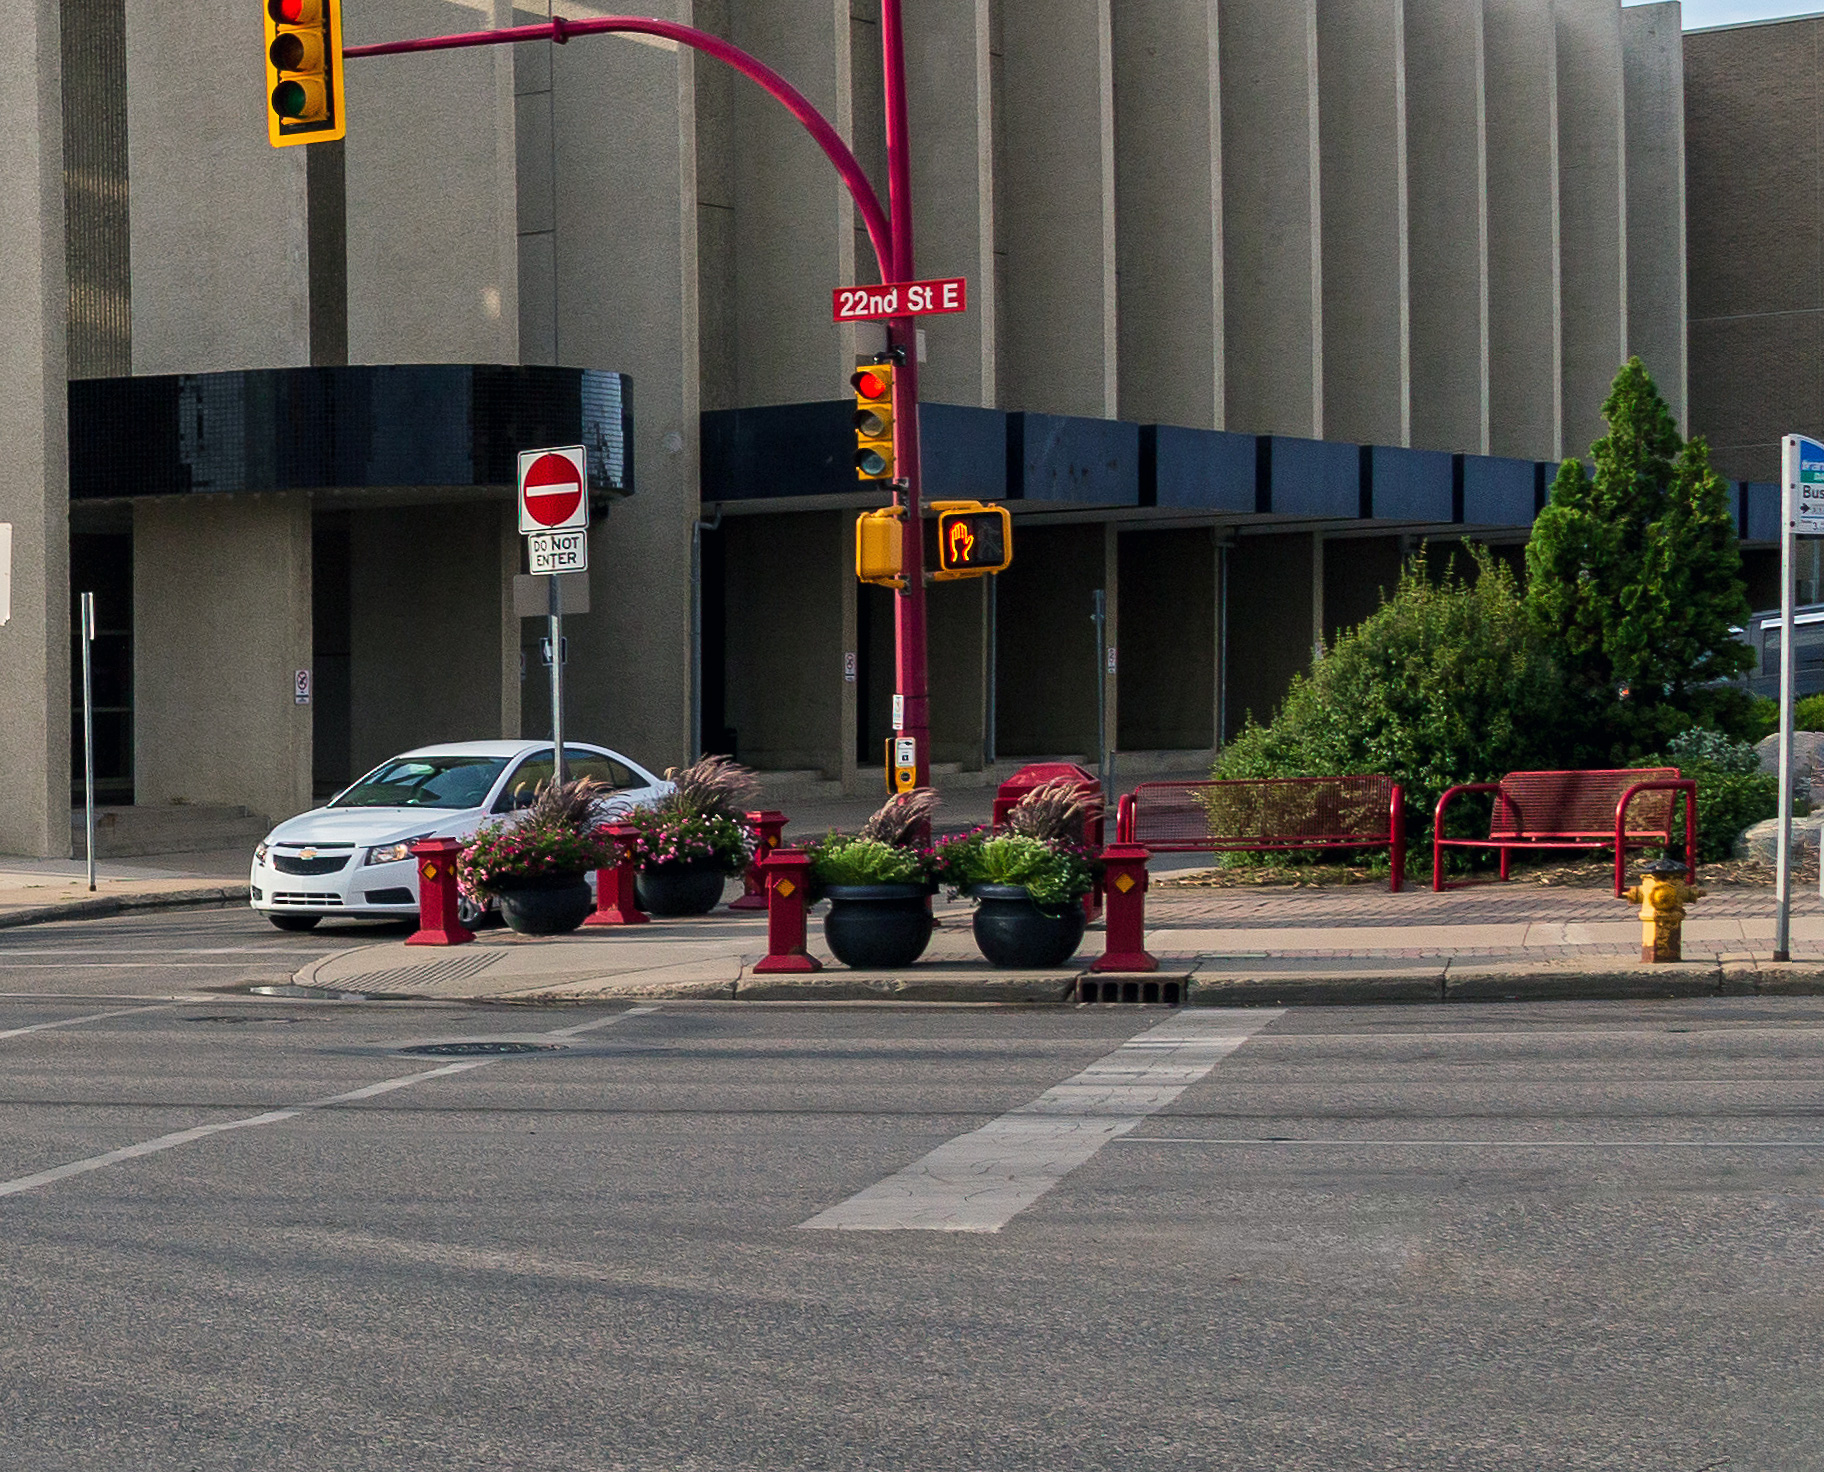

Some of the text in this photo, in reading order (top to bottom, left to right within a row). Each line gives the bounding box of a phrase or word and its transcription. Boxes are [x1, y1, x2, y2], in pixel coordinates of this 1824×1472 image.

[840, 283, 959, 317] 22nd St E
[534, 536, 579, 552] DO NOT
[537, 552, 576, 567] ENTER
